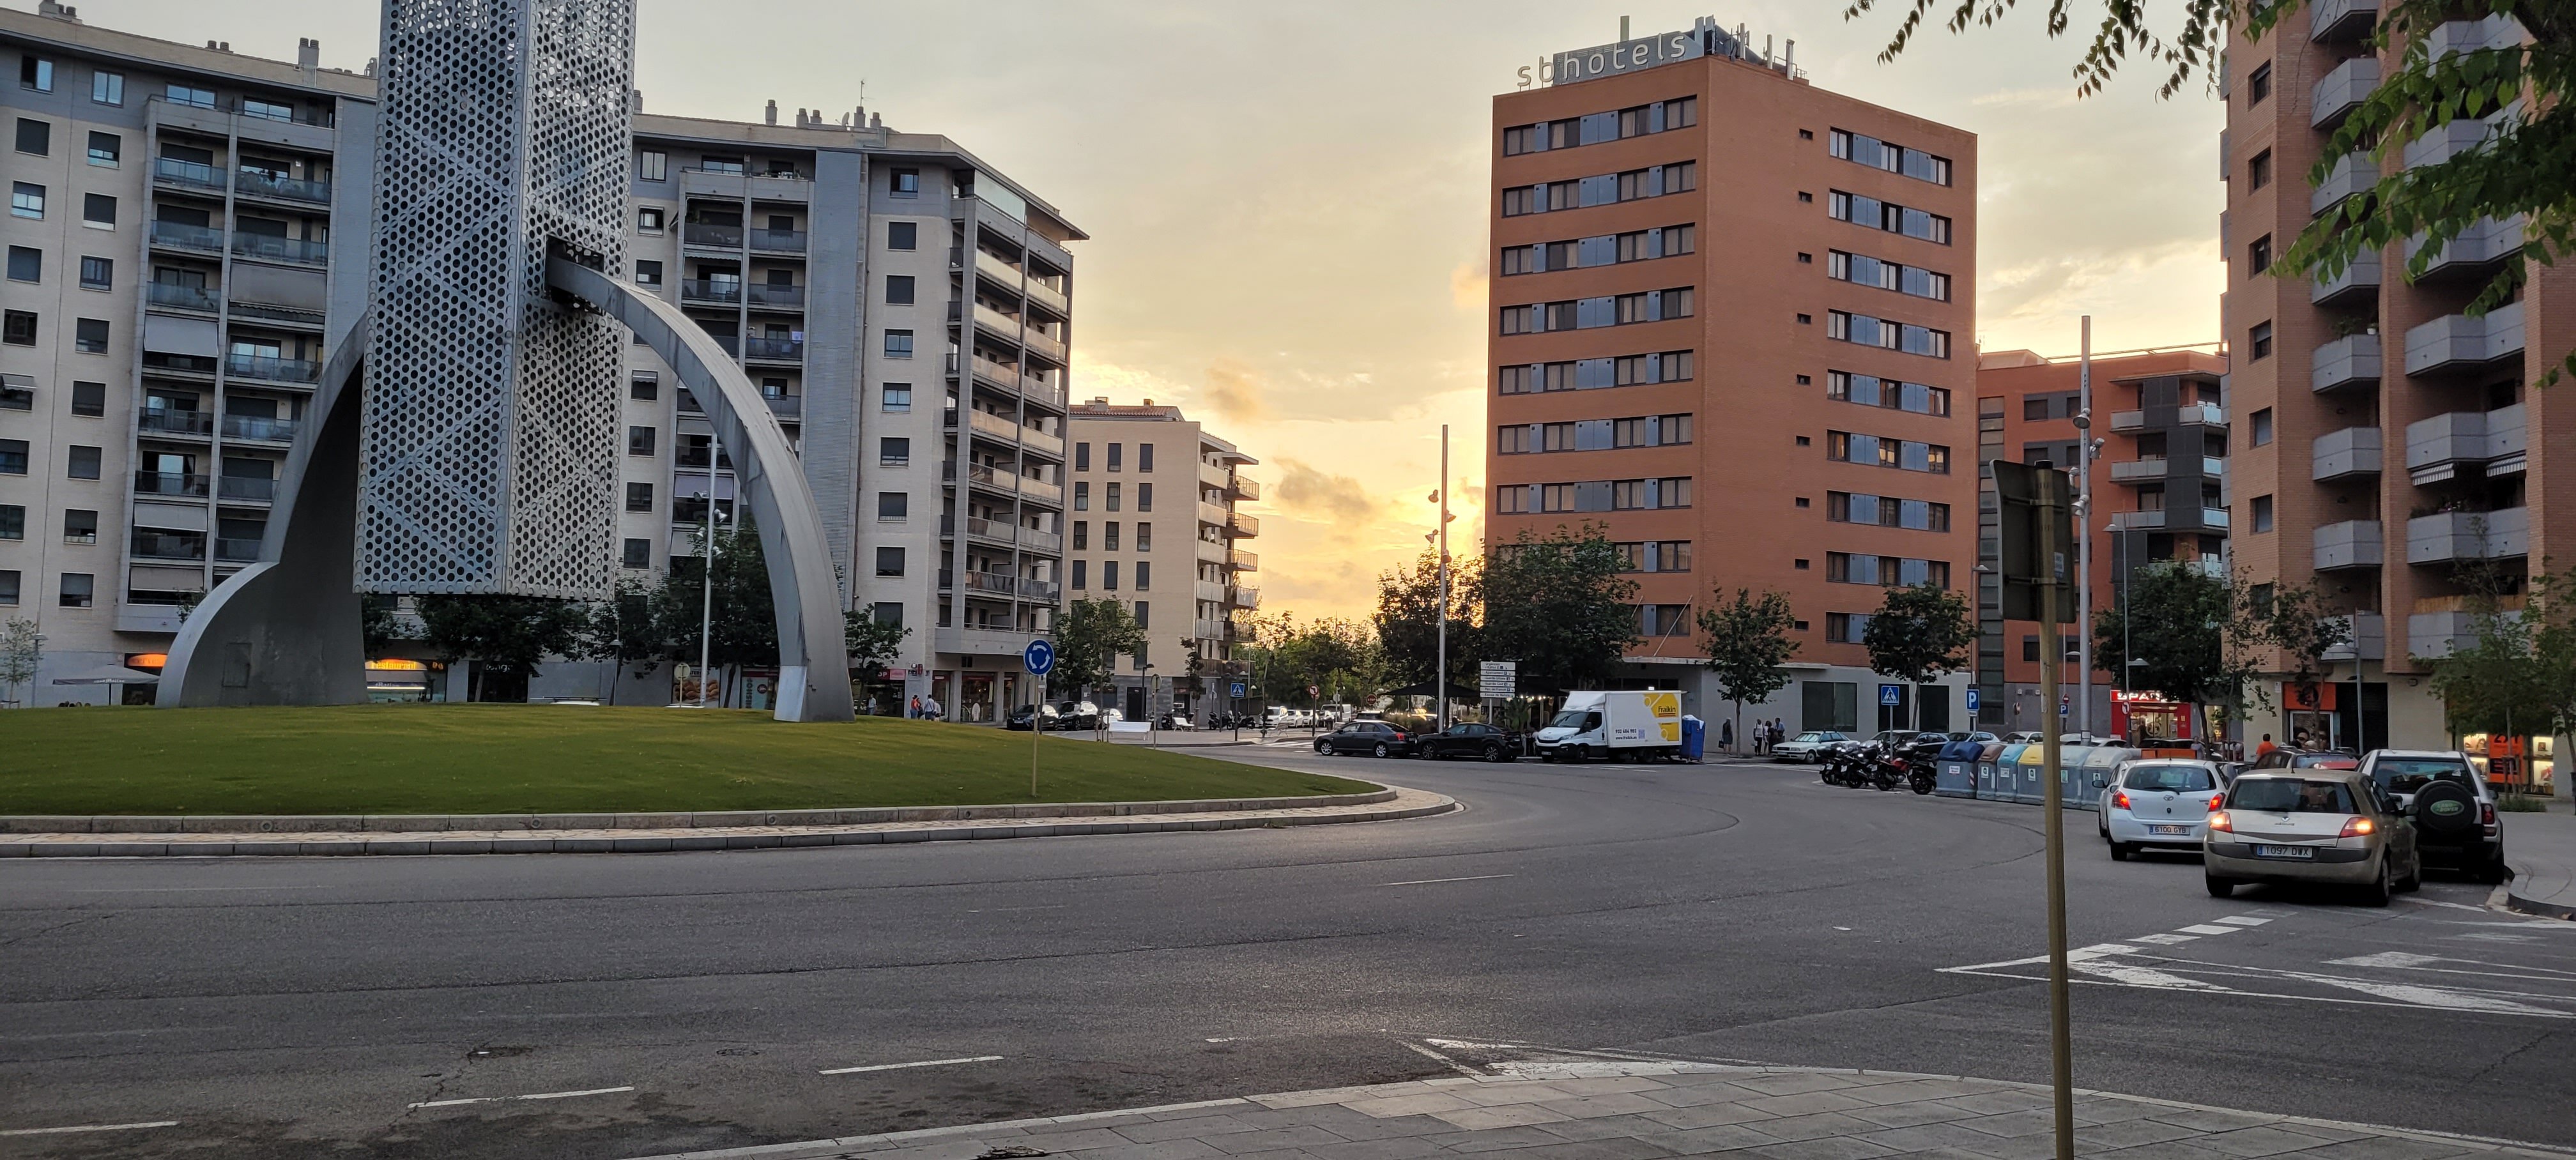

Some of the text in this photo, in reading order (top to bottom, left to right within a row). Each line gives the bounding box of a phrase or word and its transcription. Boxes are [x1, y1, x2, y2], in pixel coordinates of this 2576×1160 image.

[1969, 692, 1977, 708] P
[2060, 705, 2067, 714] P
[2266, 846, 2309, 856] 1097 DWX
